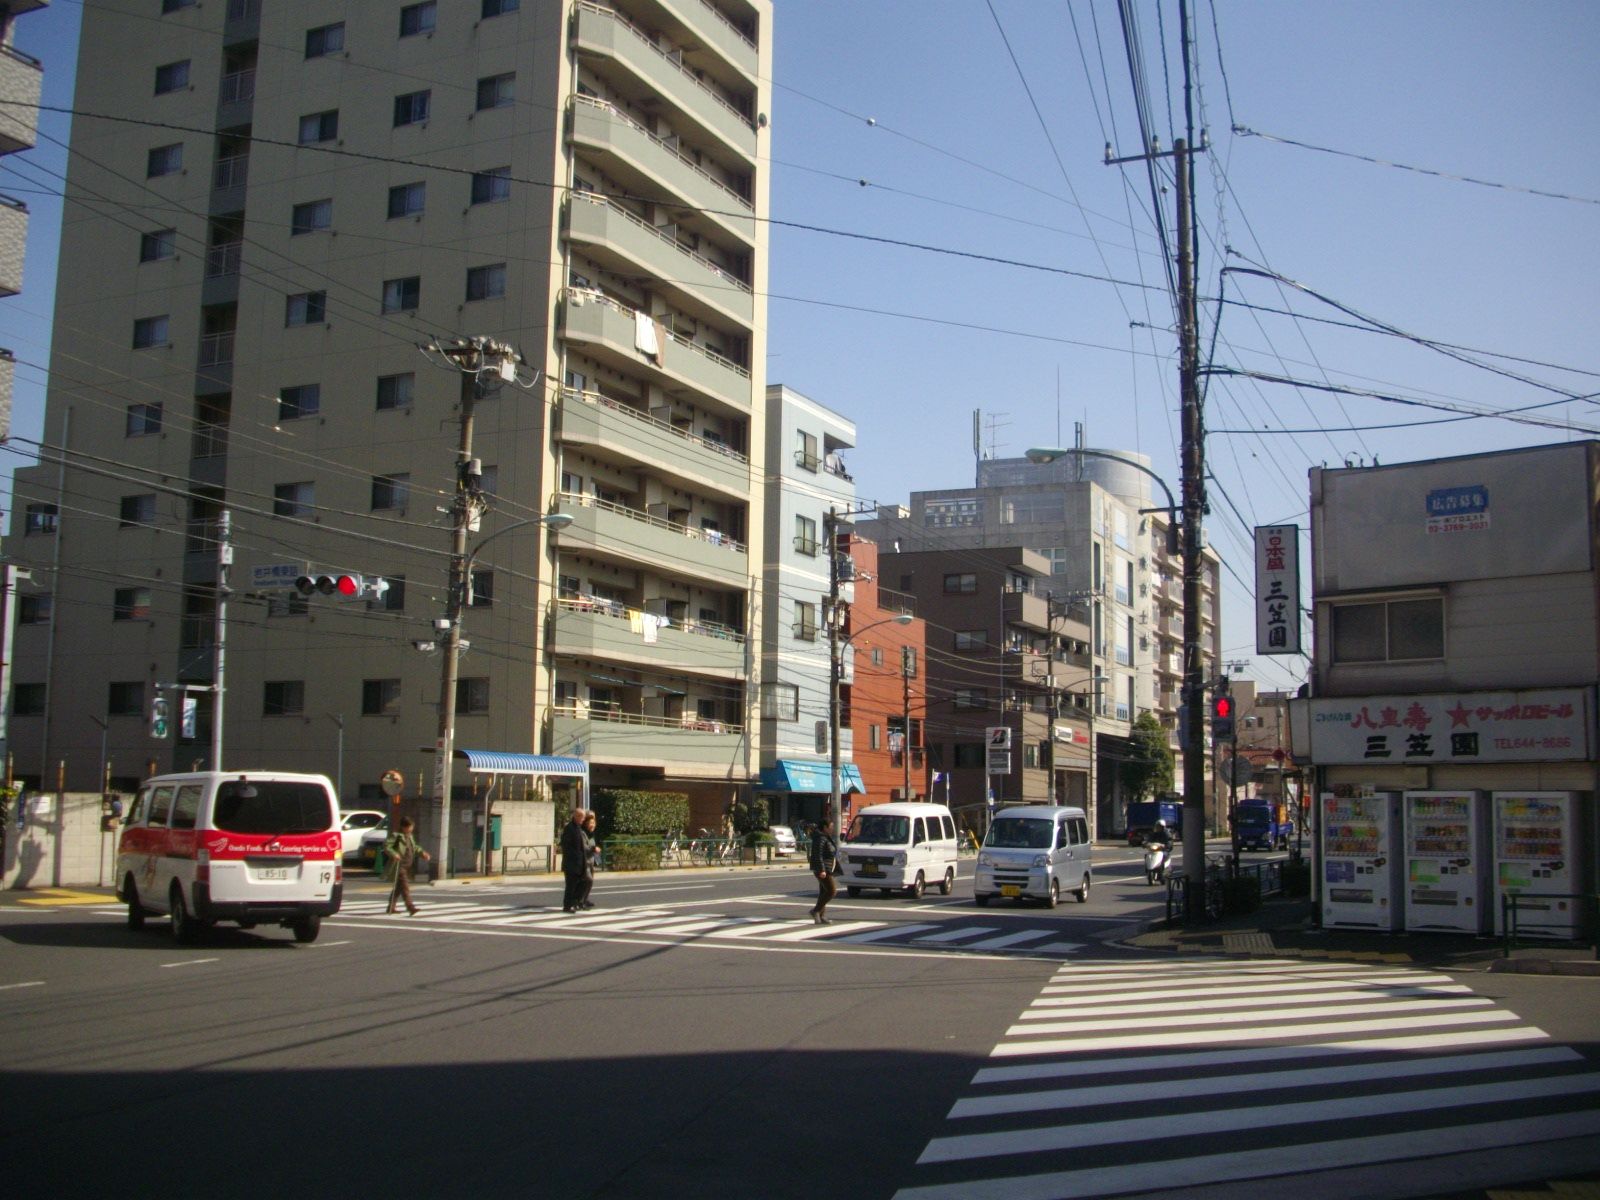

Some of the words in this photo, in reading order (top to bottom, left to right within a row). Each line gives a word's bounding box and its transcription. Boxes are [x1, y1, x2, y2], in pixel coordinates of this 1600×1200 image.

[1265, 536, 1286, 570] 日本盛
[1263, 581, 1289, 647] 三笠園
[1476, 703, 1574, 720] サッポロビール
[1364, 732, 1479, 758] 三笠園
[319, 872, 331, 884] 19
